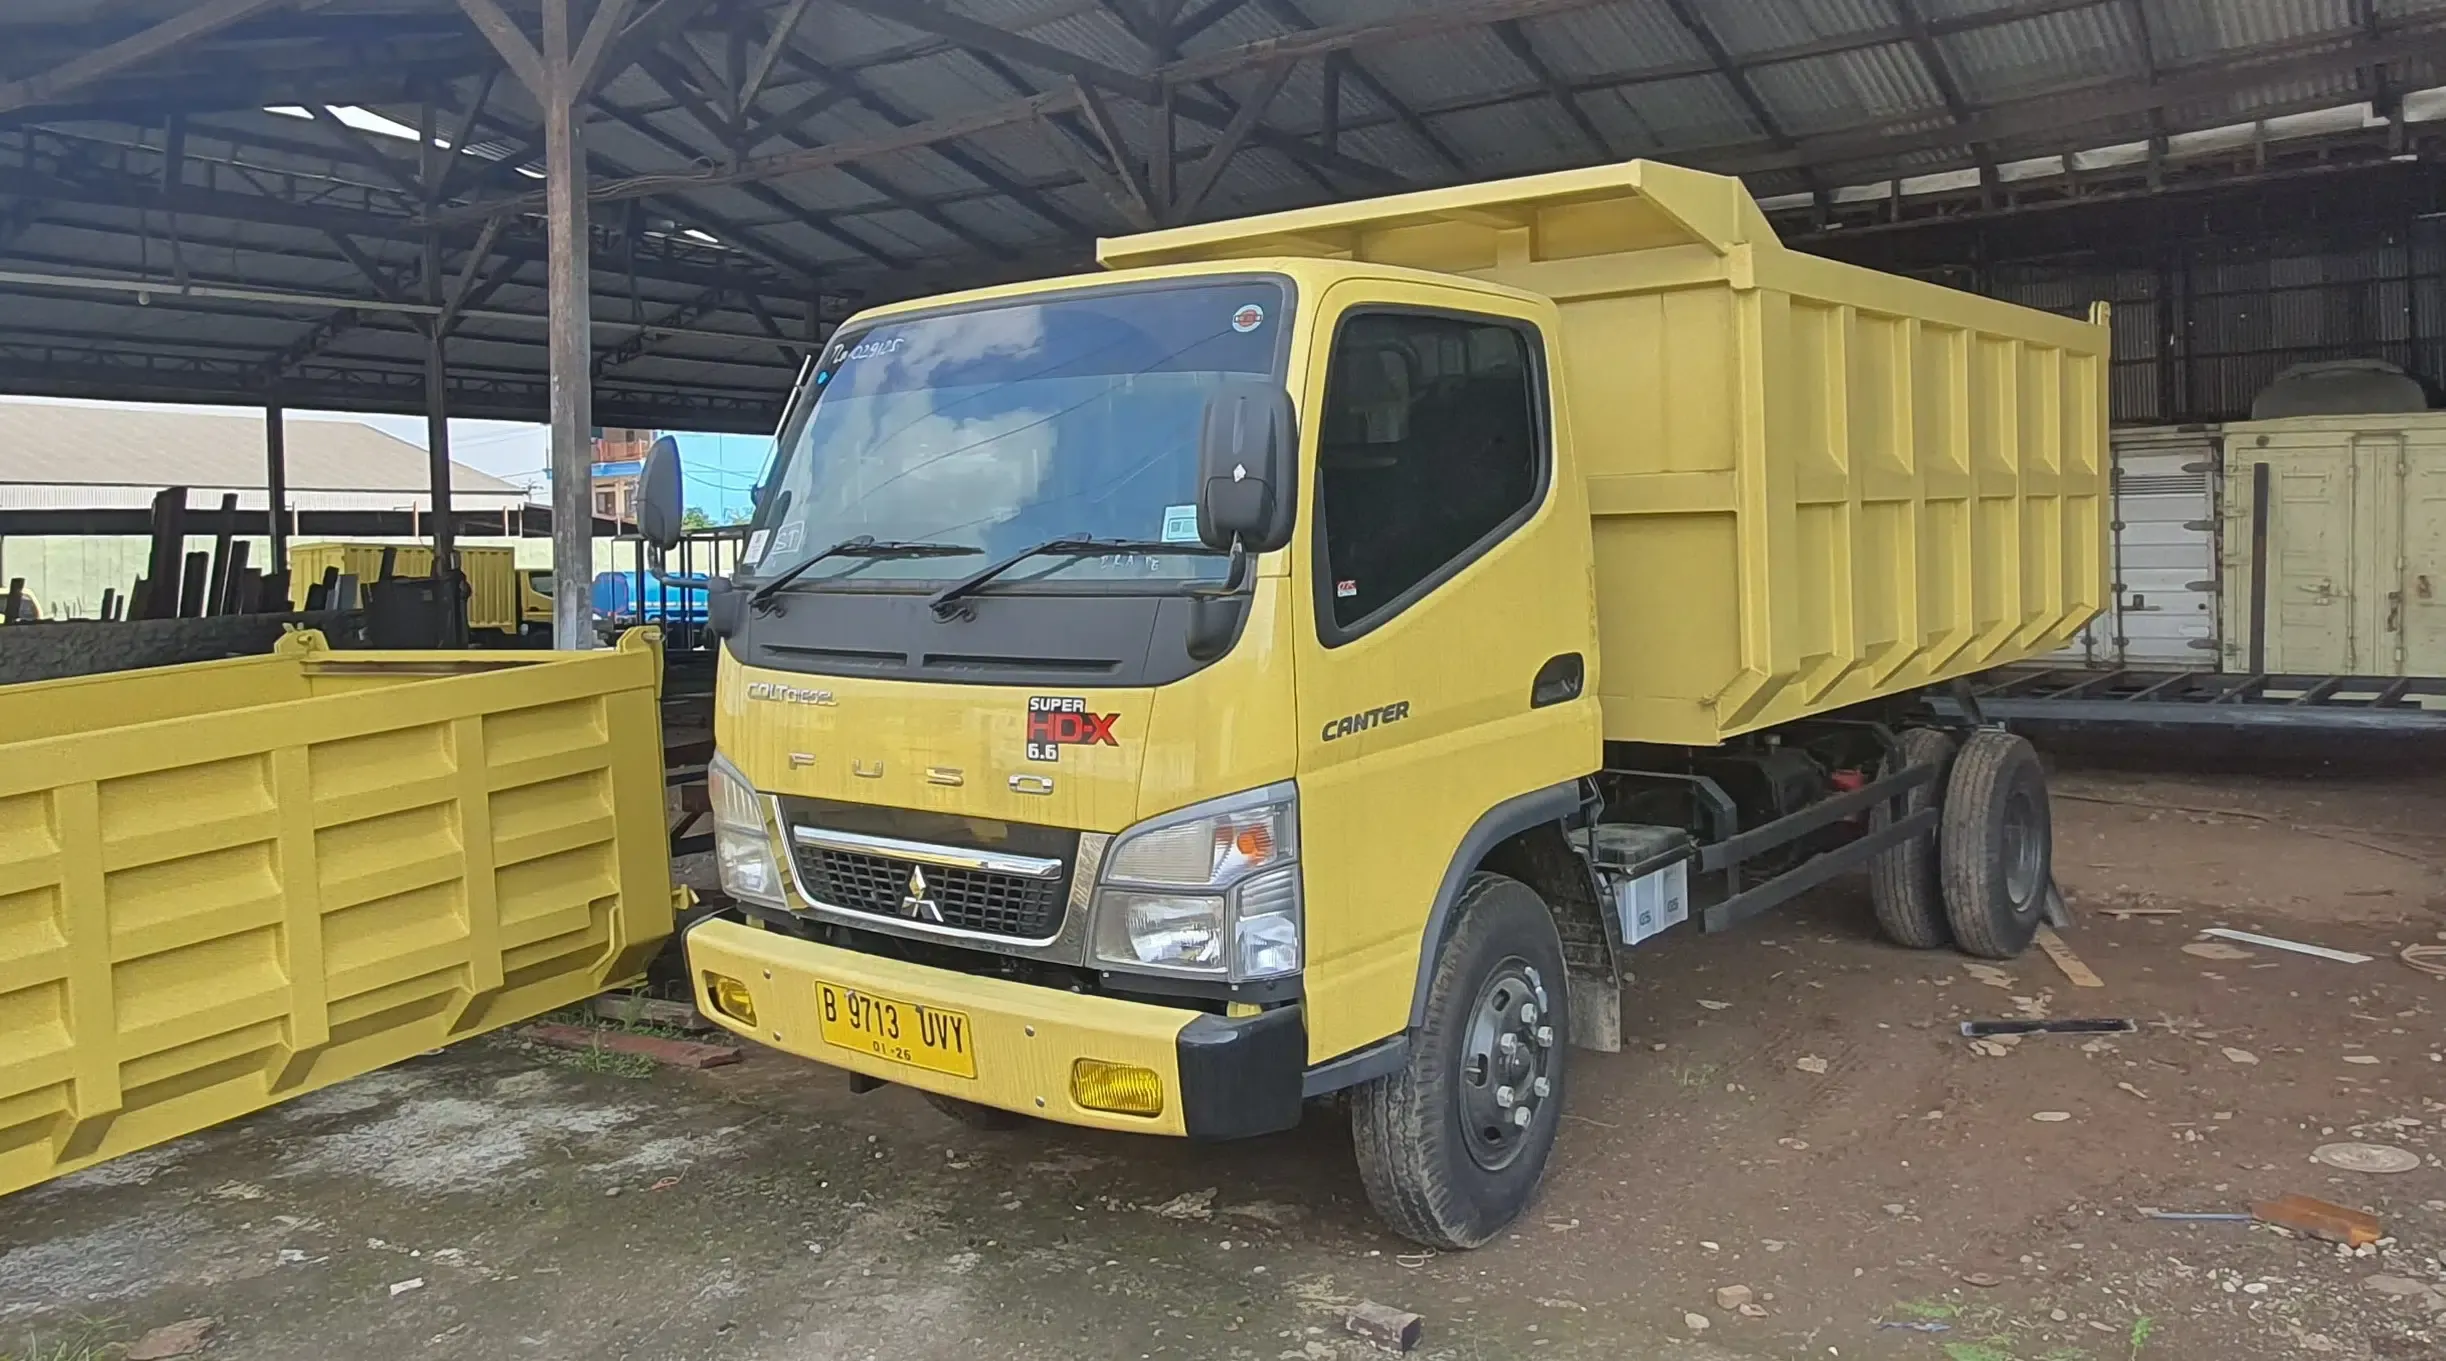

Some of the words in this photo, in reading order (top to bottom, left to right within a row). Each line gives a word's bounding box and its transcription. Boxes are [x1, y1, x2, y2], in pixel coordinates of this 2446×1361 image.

[1029, 697, 1084, 713] SUPER
[1321, 700, 1410, 742] CANTER
[1027, 712, 1121, 747] HD-X
[1027, 743, 1057, 760] 6.6
[788, 752, 1054, 796] FUSO
[823, 986, 837, 1023] B
[848, 993, 900, 1040] 9713
[917, 1007, 962, 1053] UVY
